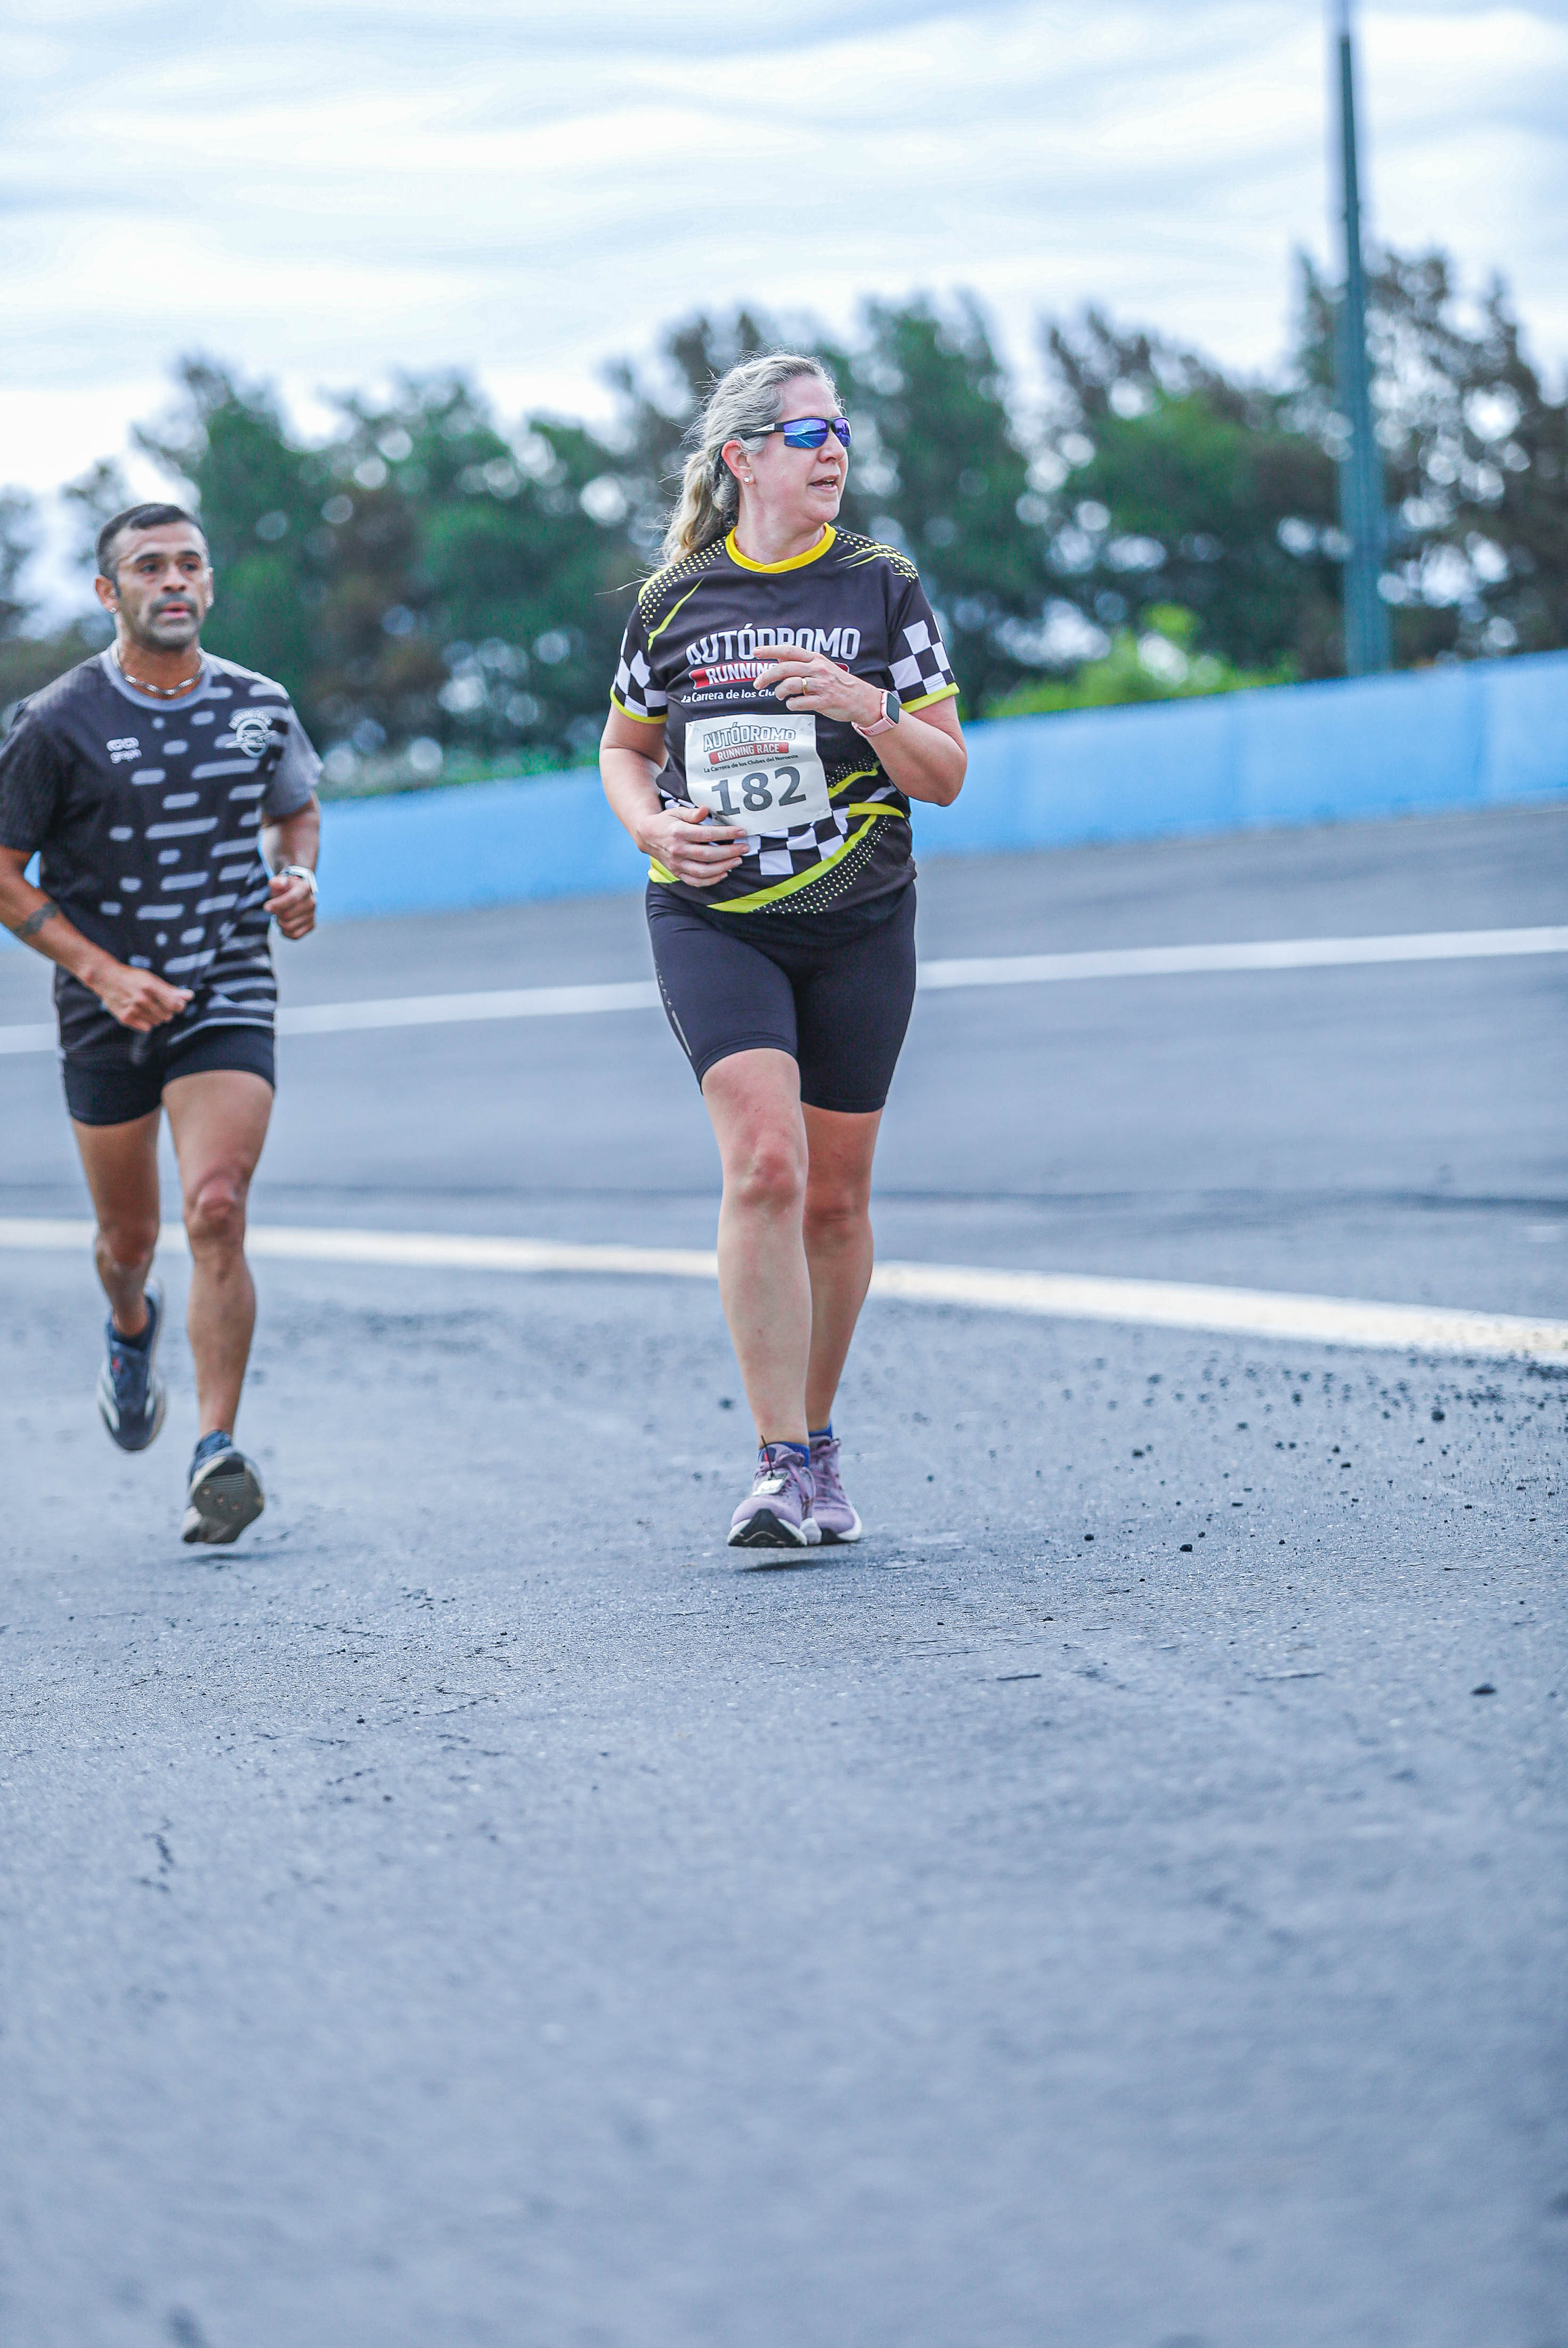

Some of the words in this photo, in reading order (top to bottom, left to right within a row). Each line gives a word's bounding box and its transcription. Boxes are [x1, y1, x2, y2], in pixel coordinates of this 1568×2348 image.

[680, 695, 691, 703] La
[692, 692, 724, 703] Carrera
[726, 689, 740, 699] de
[741, 689, 756, 698] los
[703, 722, 796, 752] AUTÓDROMO
[717, 745, 755, 762] RUNNING
[757, 743, 780, 754] RACE
[711, 766, 807, 816] 182
